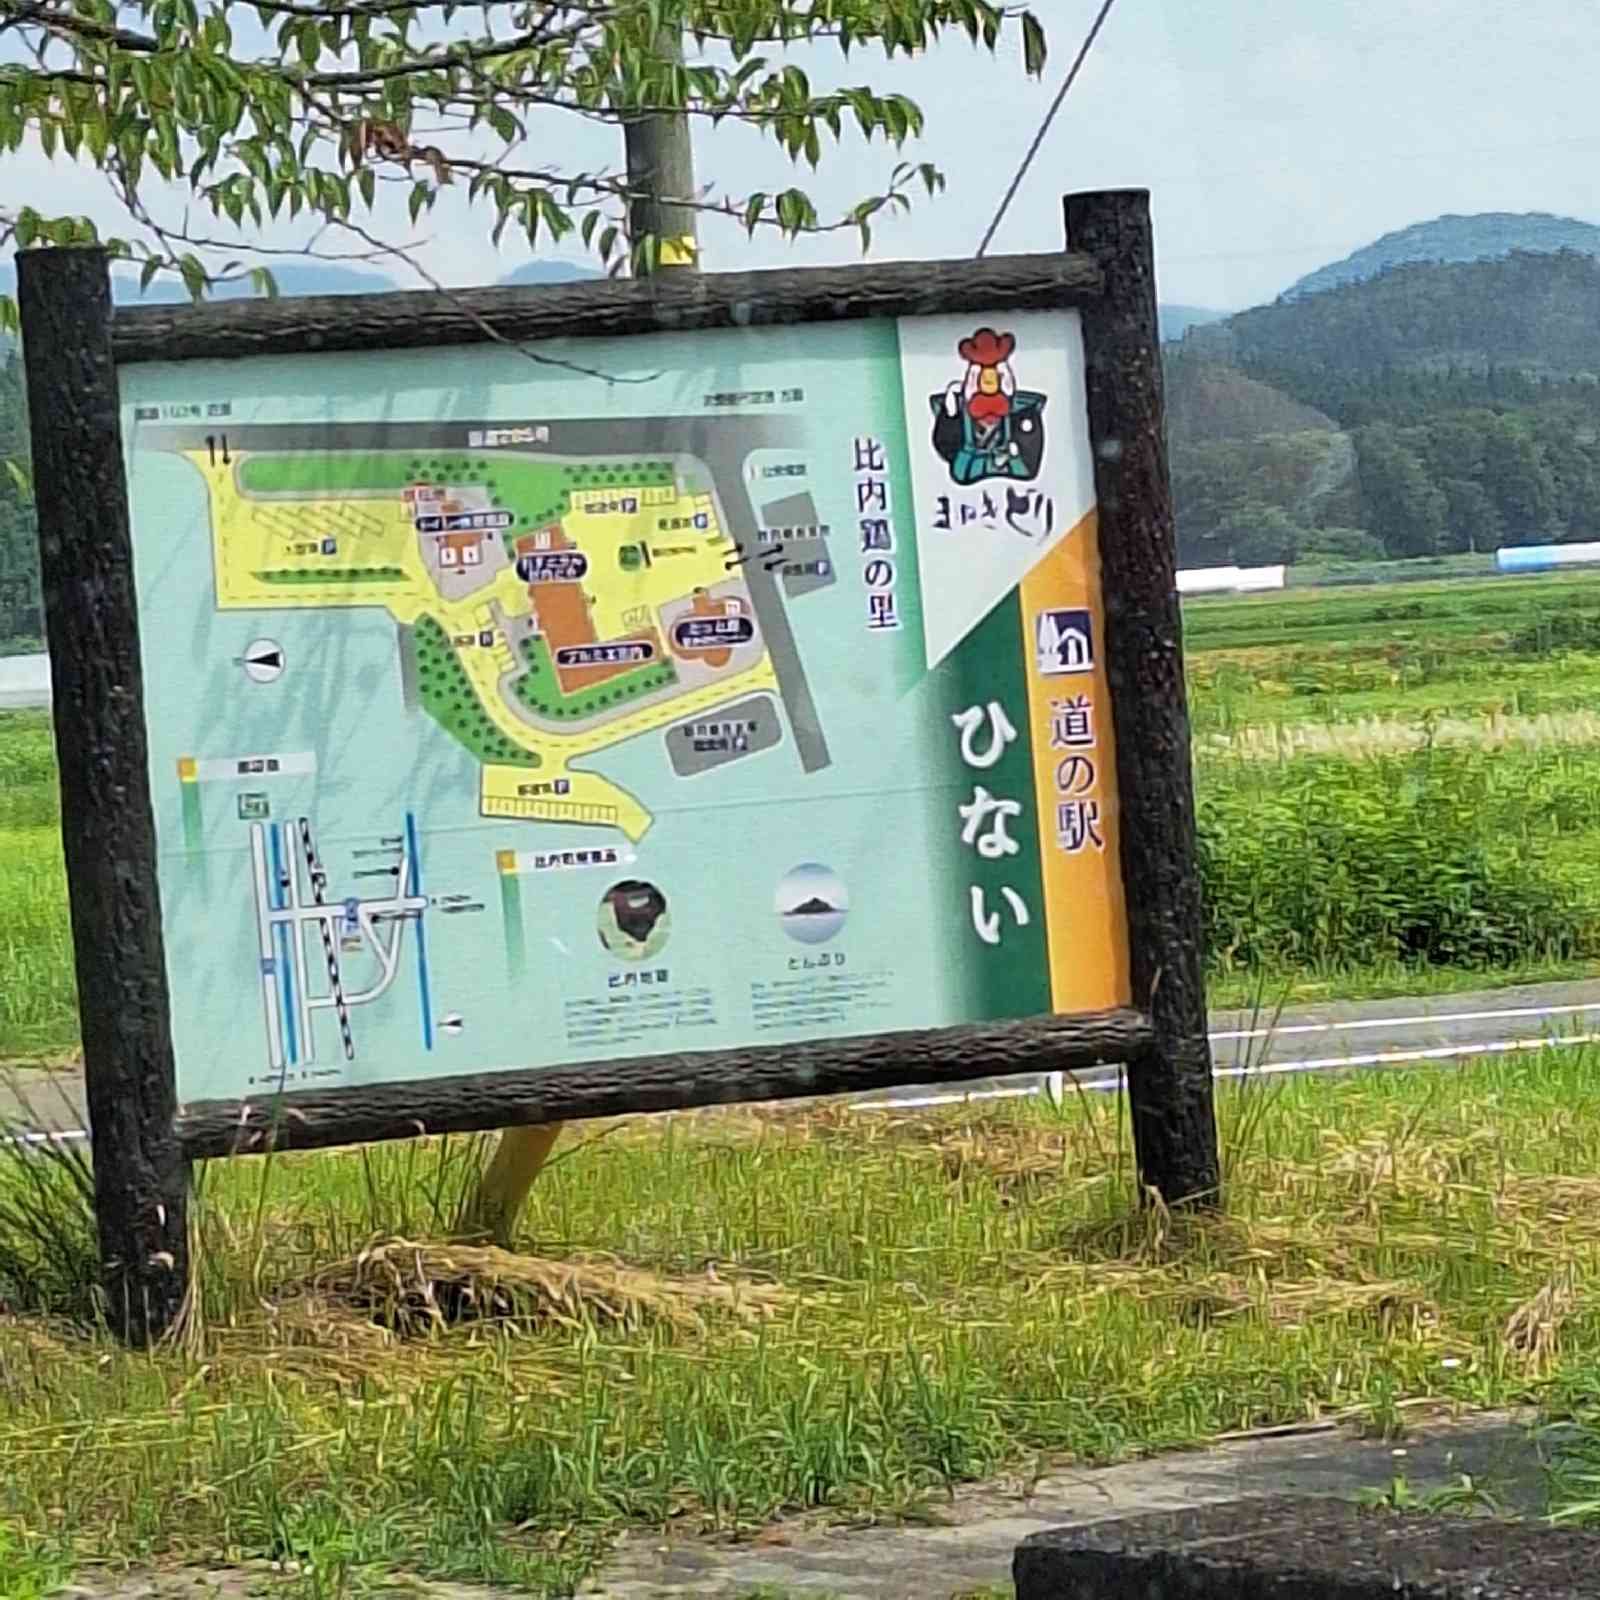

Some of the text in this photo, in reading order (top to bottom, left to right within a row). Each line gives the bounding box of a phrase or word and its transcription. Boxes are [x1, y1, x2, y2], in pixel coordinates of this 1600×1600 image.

[951, 701, 1030, 944] ひない
[1050, 696, 1104, 853] 道の駅
